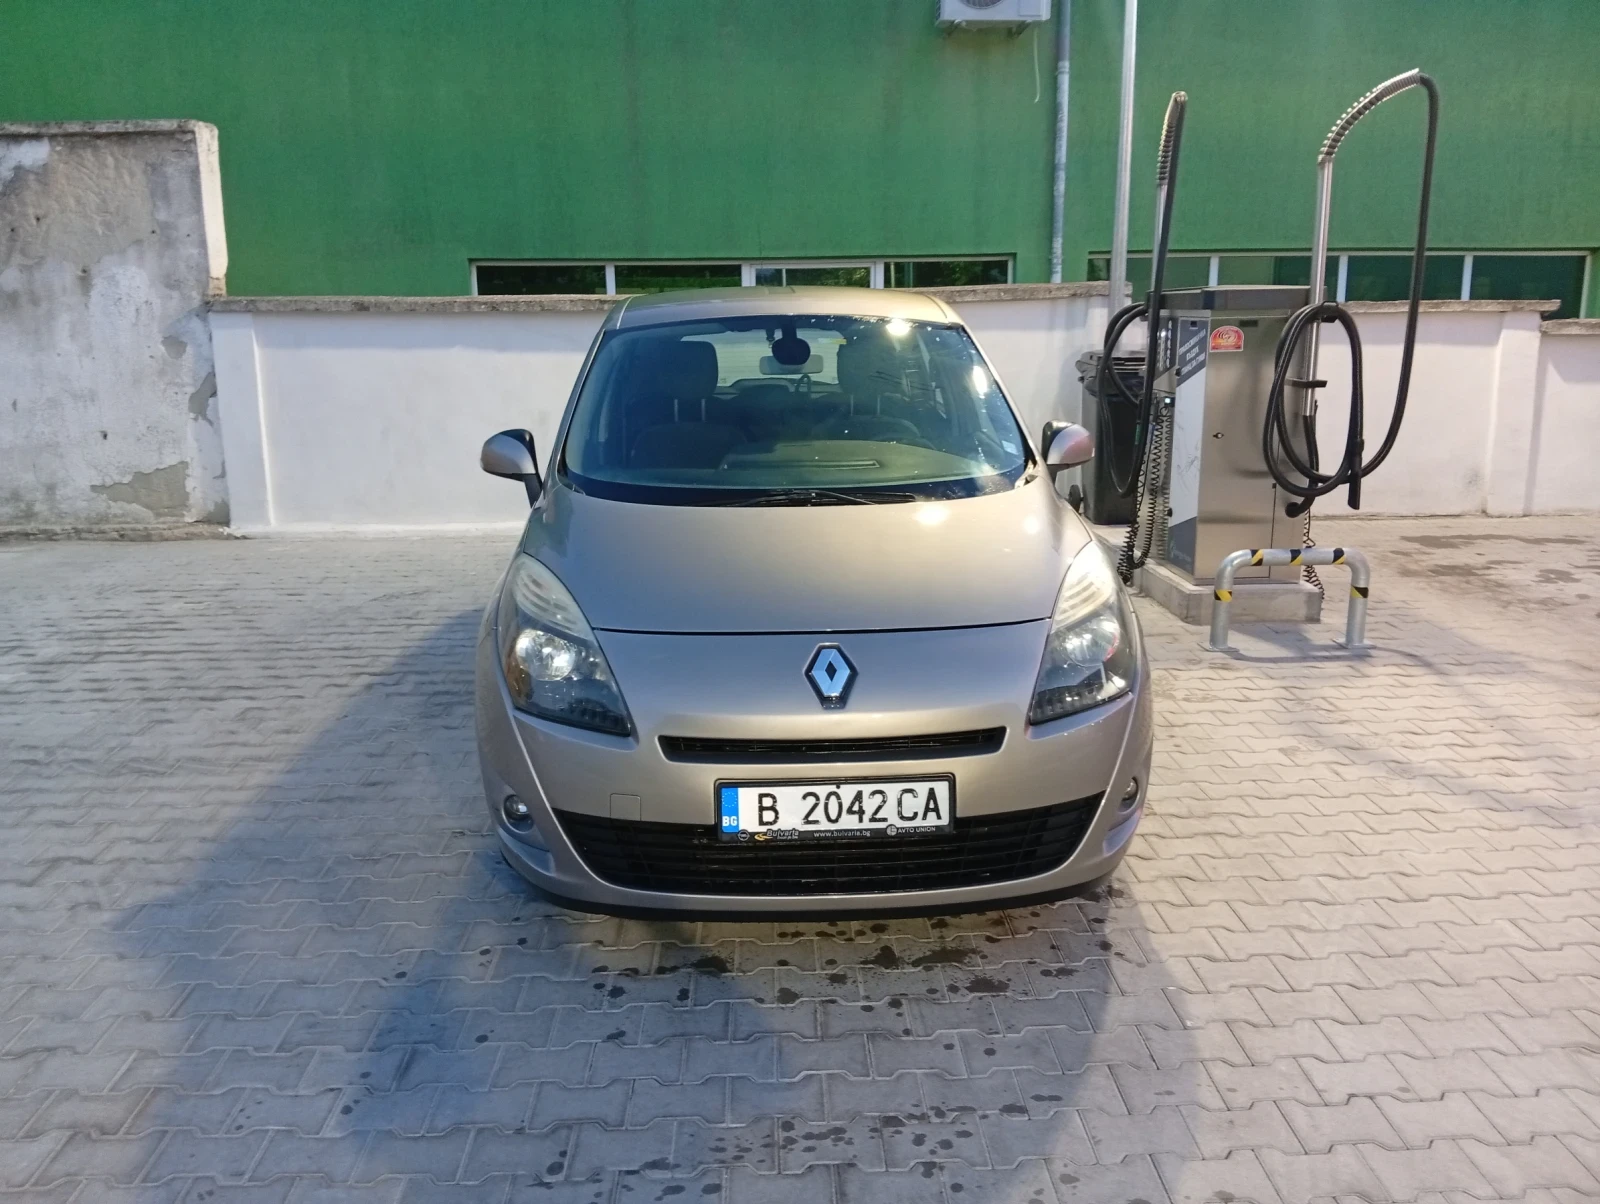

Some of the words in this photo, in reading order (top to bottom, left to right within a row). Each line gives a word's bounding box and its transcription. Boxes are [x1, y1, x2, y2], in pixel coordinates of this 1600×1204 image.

[757, 792, 780, 827] B
[801, 789, 889, 825] 2042
[896, 786, 943, 822] CA
[722, 815, 738, 827] BG
[813, 830, 870, 838] www.bulvaria.bg
